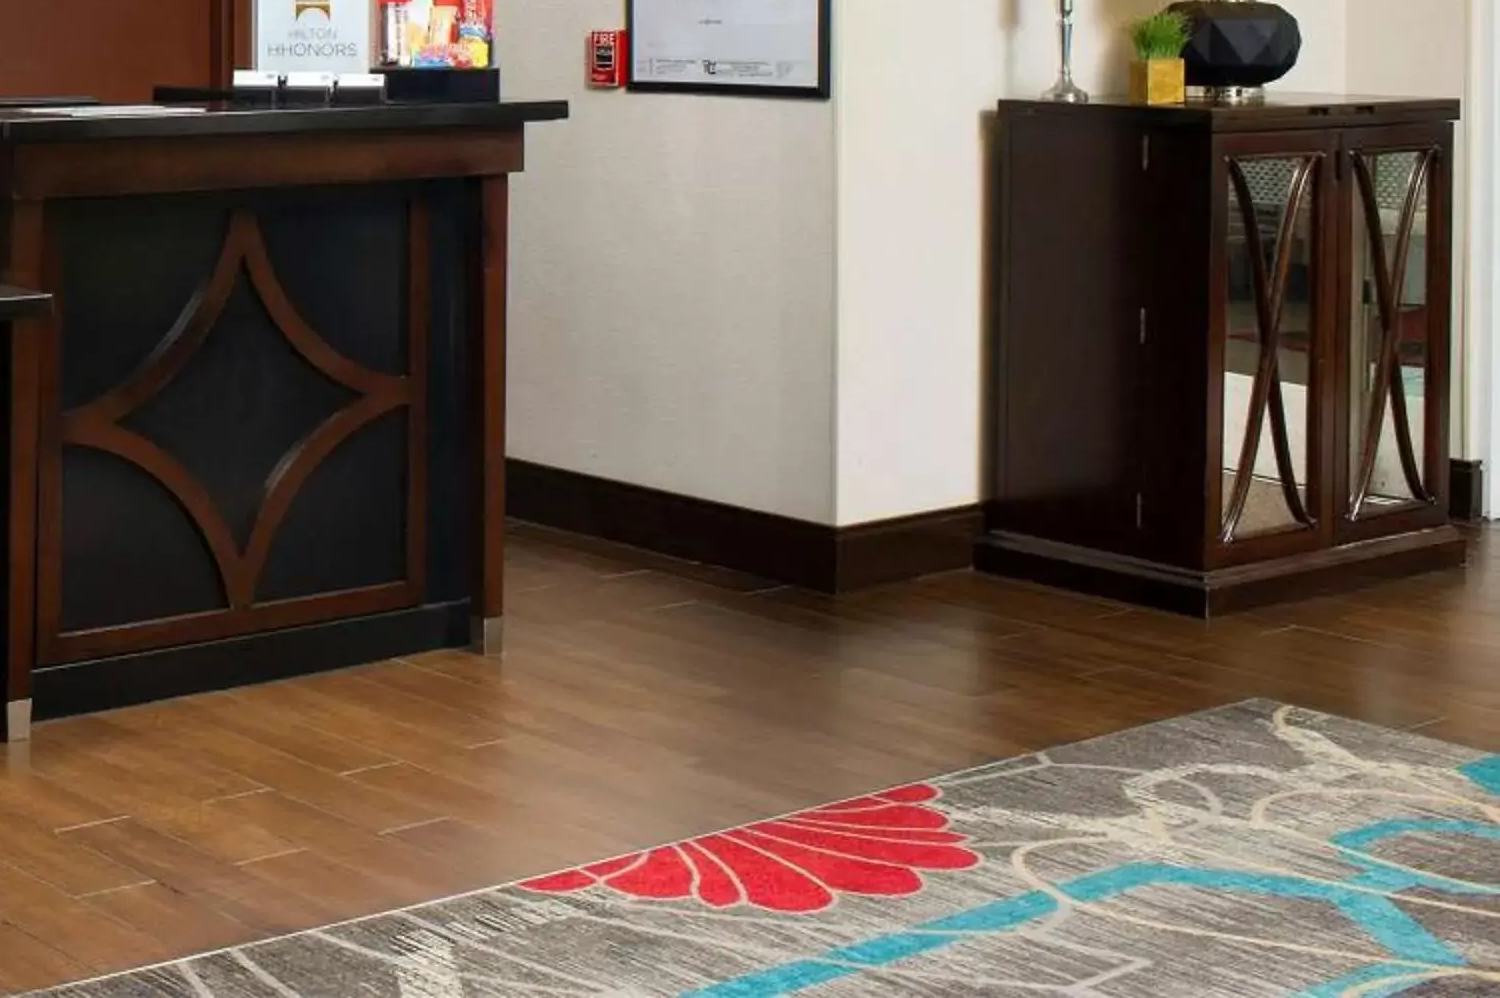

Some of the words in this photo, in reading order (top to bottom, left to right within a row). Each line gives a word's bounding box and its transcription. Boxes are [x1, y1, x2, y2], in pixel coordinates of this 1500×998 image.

[288, 28, 337, 40] HILTON
[594, 33, 616, 46] FIRE
[267, 42, 357, 57] HHONORS
